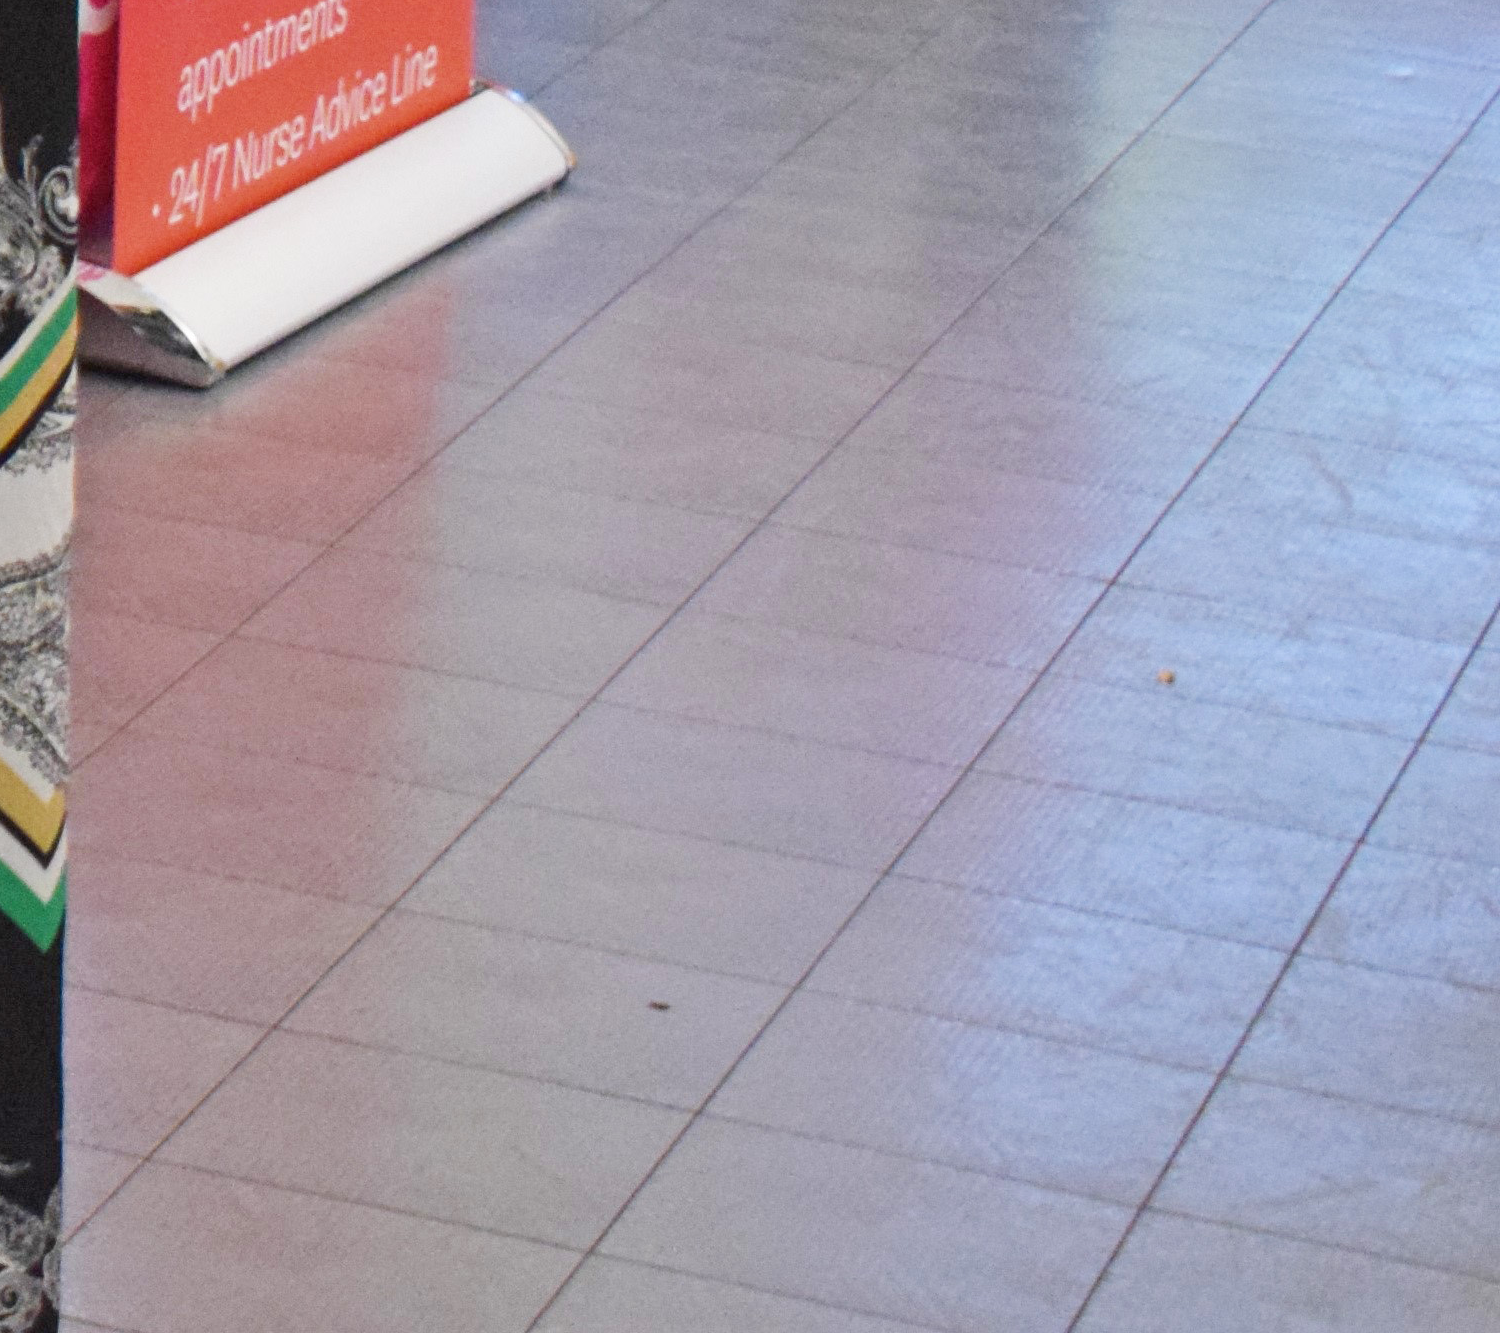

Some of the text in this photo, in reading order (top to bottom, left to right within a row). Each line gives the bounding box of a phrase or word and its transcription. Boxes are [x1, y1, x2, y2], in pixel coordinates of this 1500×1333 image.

[168, 39, 439, 228] 24/7 Nurse Advice Line
